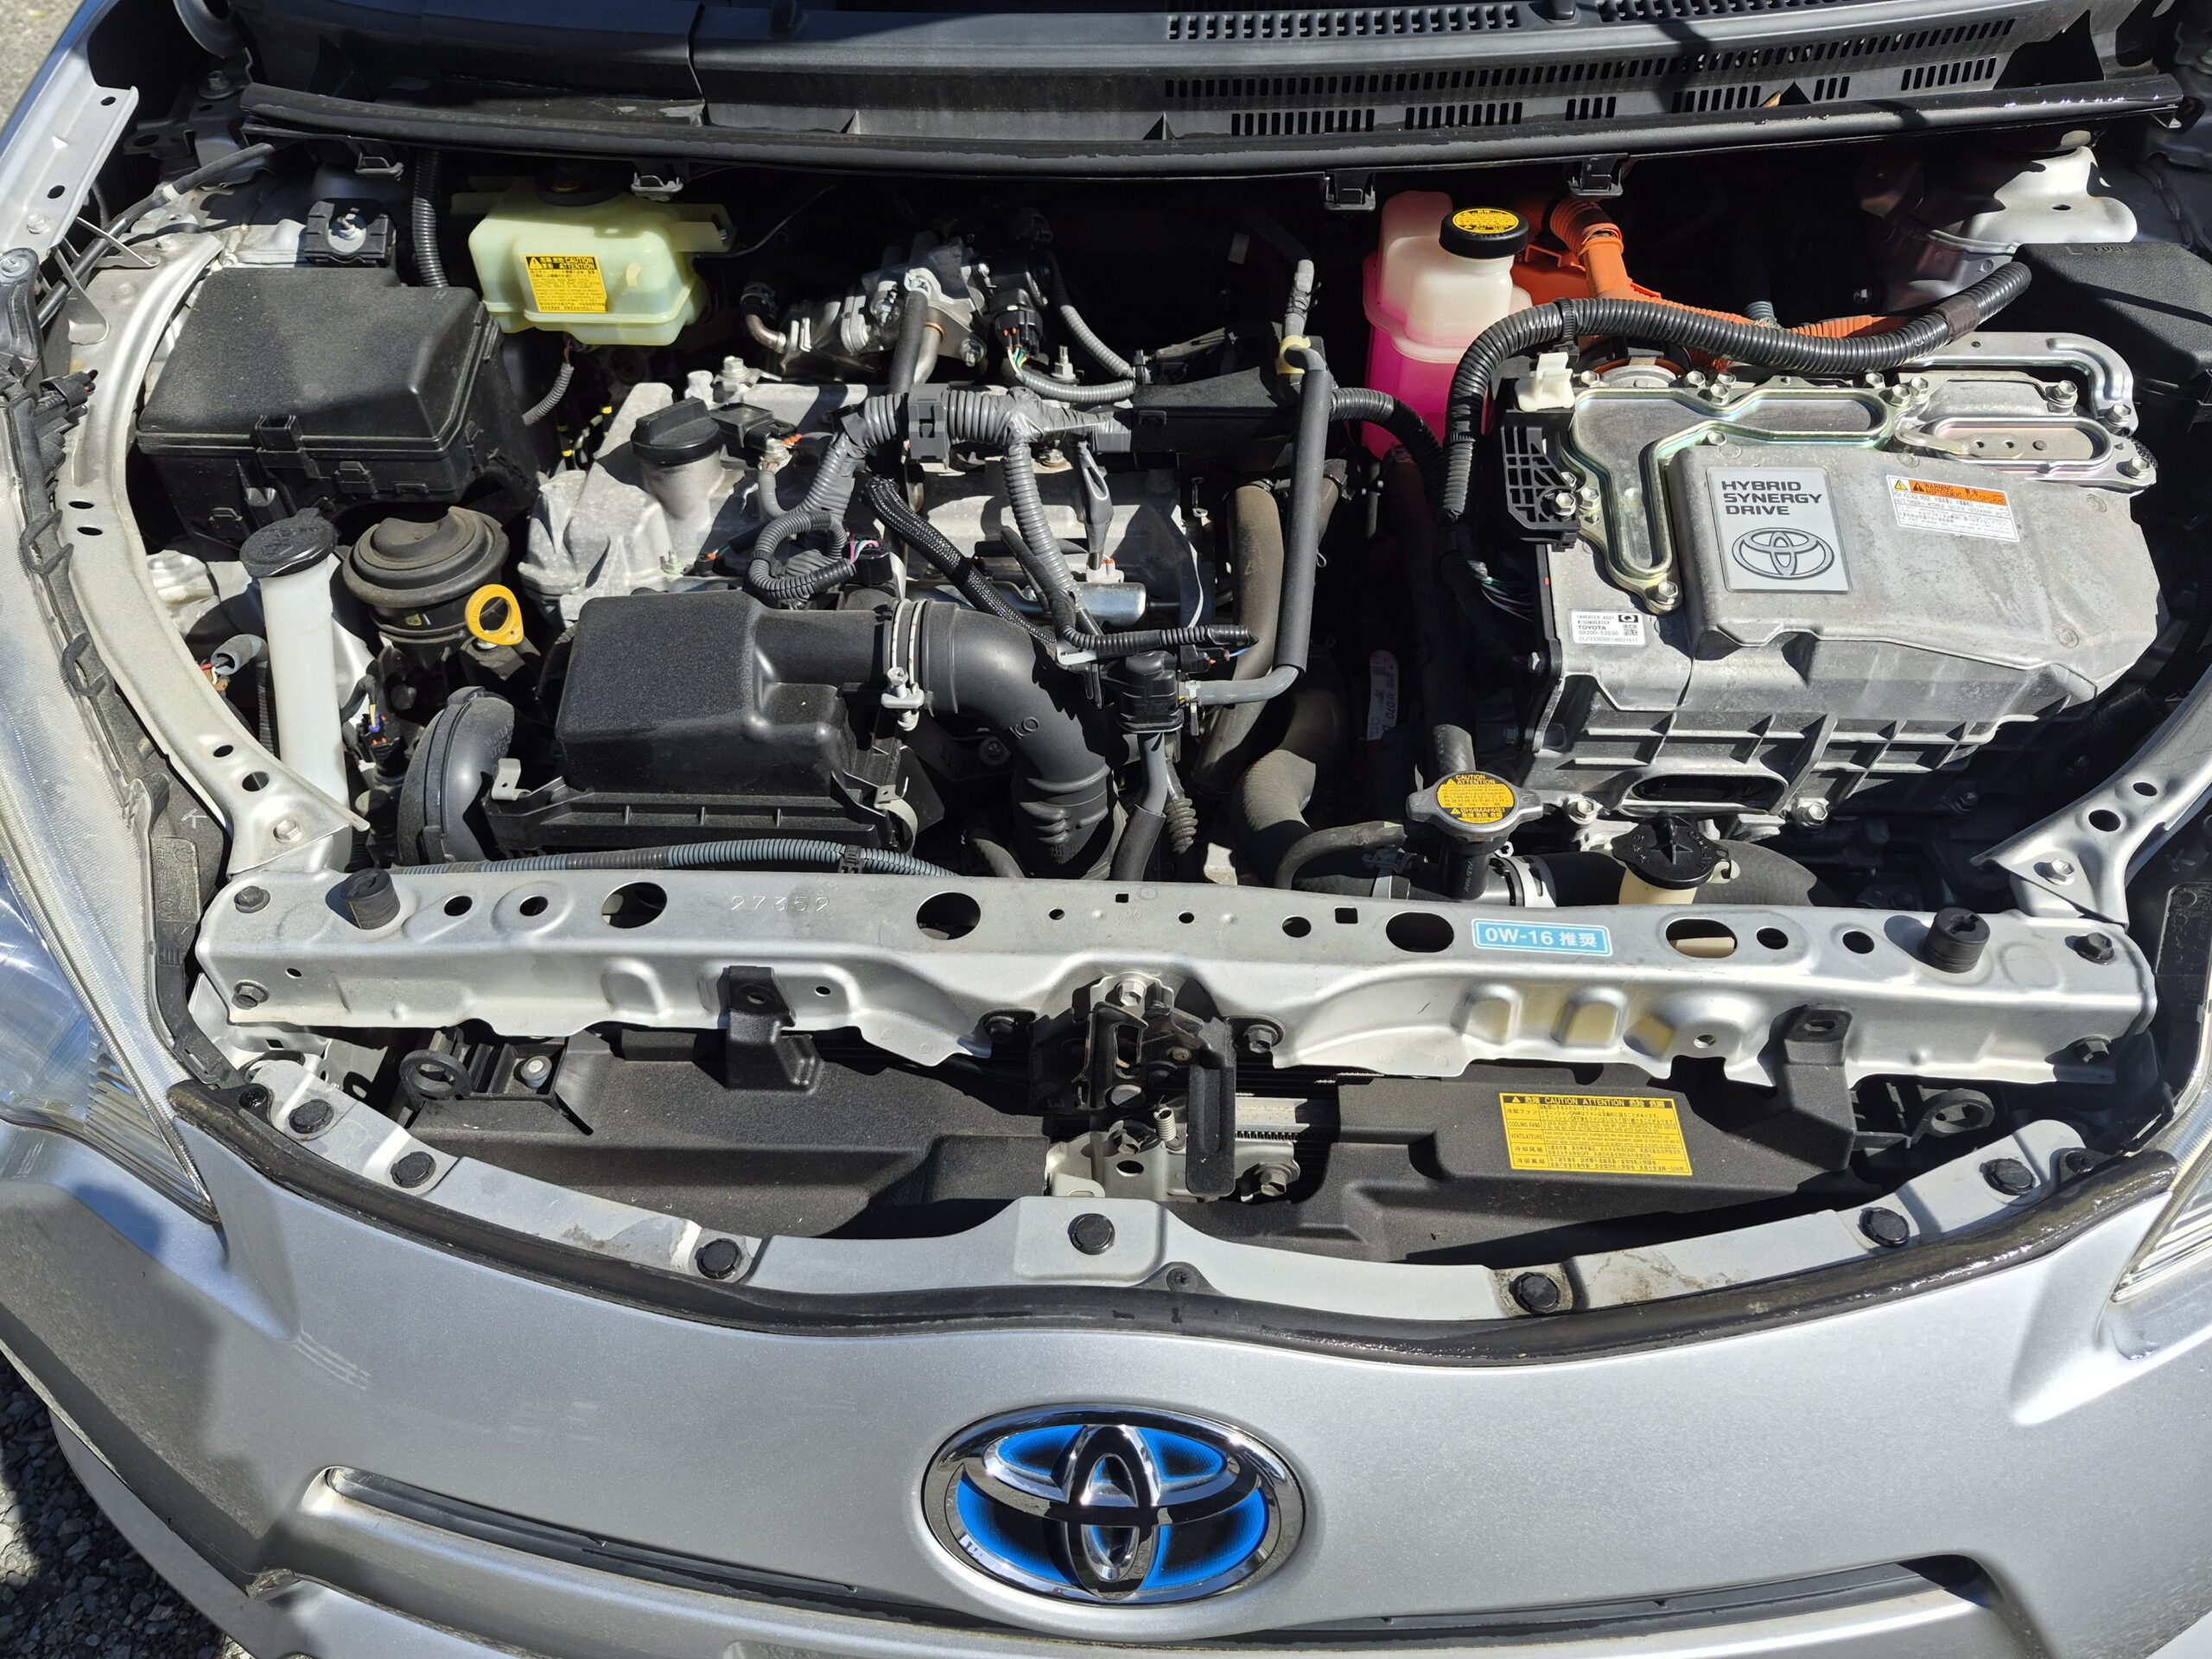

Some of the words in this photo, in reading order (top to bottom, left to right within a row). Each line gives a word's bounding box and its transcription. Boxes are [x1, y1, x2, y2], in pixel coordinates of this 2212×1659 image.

[1721, 480, 1802, 491] HYBRID
[1924, 482, 1954, 493] WARNING
[1723, 493, 1822, 504] SYNERGY
[1726, 505, 1790, 515] DRIVE
[730, 895, 830, 912] 97359
[1484, 927, 1554, 946] 0W-16
[1559, 931, 1597, 948] 推奨
[1544, 1096, 1579, 1105] CAUTION
